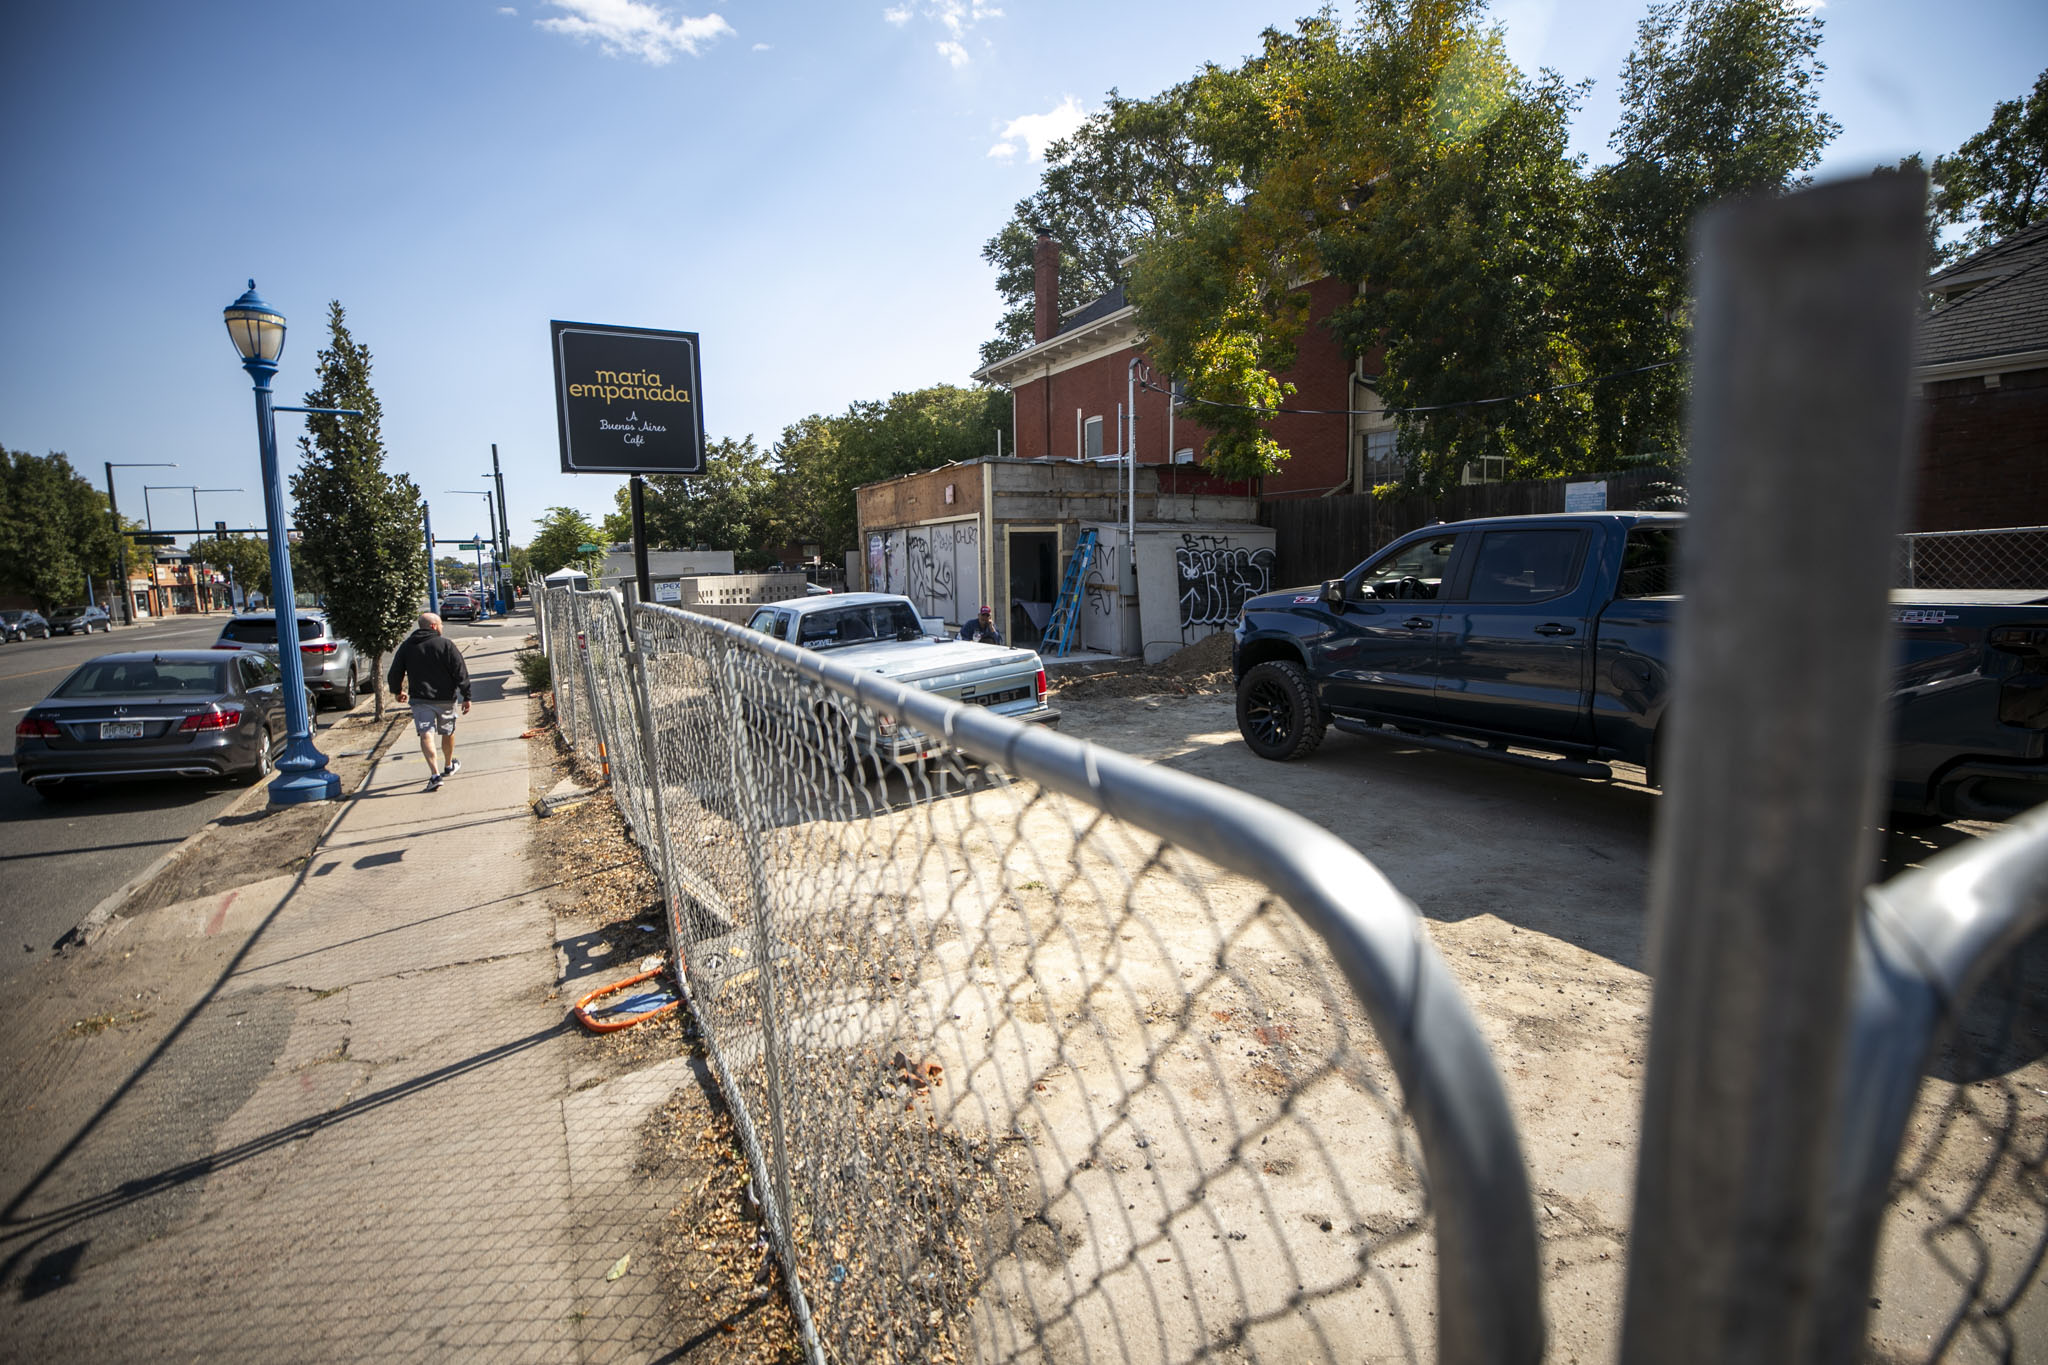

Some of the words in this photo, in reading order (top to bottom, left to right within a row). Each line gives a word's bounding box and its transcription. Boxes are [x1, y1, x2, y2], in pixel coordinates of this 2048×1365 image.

[595, 369, 662, 387] maria
[569, 384, 691, 405] empanada
[626, 411, 638, 421] A
[600, 419, 635, 431] Buenos
[638, 421, 667, 432] Aires
[623, 433, 645, 447] Café
[1182, 534, 1229, 549] BTM
